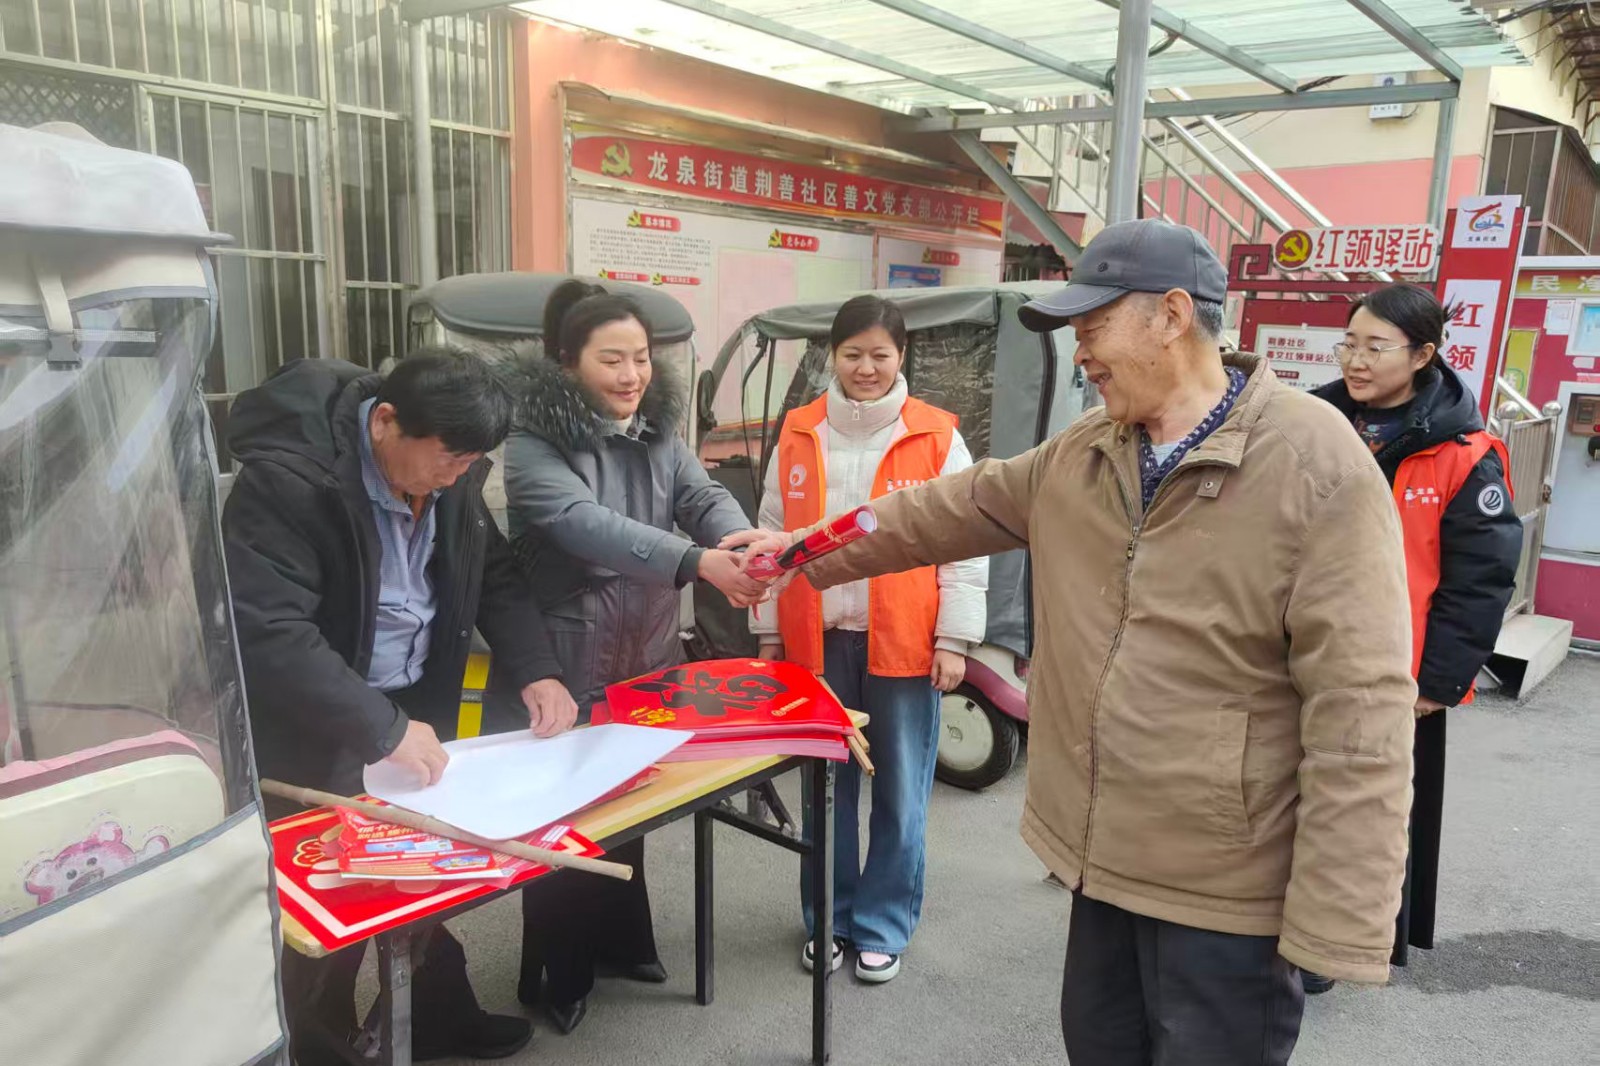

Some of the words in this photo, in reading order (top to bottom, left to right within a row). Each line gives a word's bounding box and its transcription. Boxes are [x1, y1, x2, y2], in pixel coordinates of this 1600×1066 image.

[647, 151, 980, 225] 龙泉街道荆善社区善文党支部公开栏
[1314, 228, 1433, 268] 红领驿站
[1266, 350, 1340, 363] 善文红领驿站公
[1267, 336, 1306, 348] 荆善社区
[1446, 302, 1484, 372] 红领
